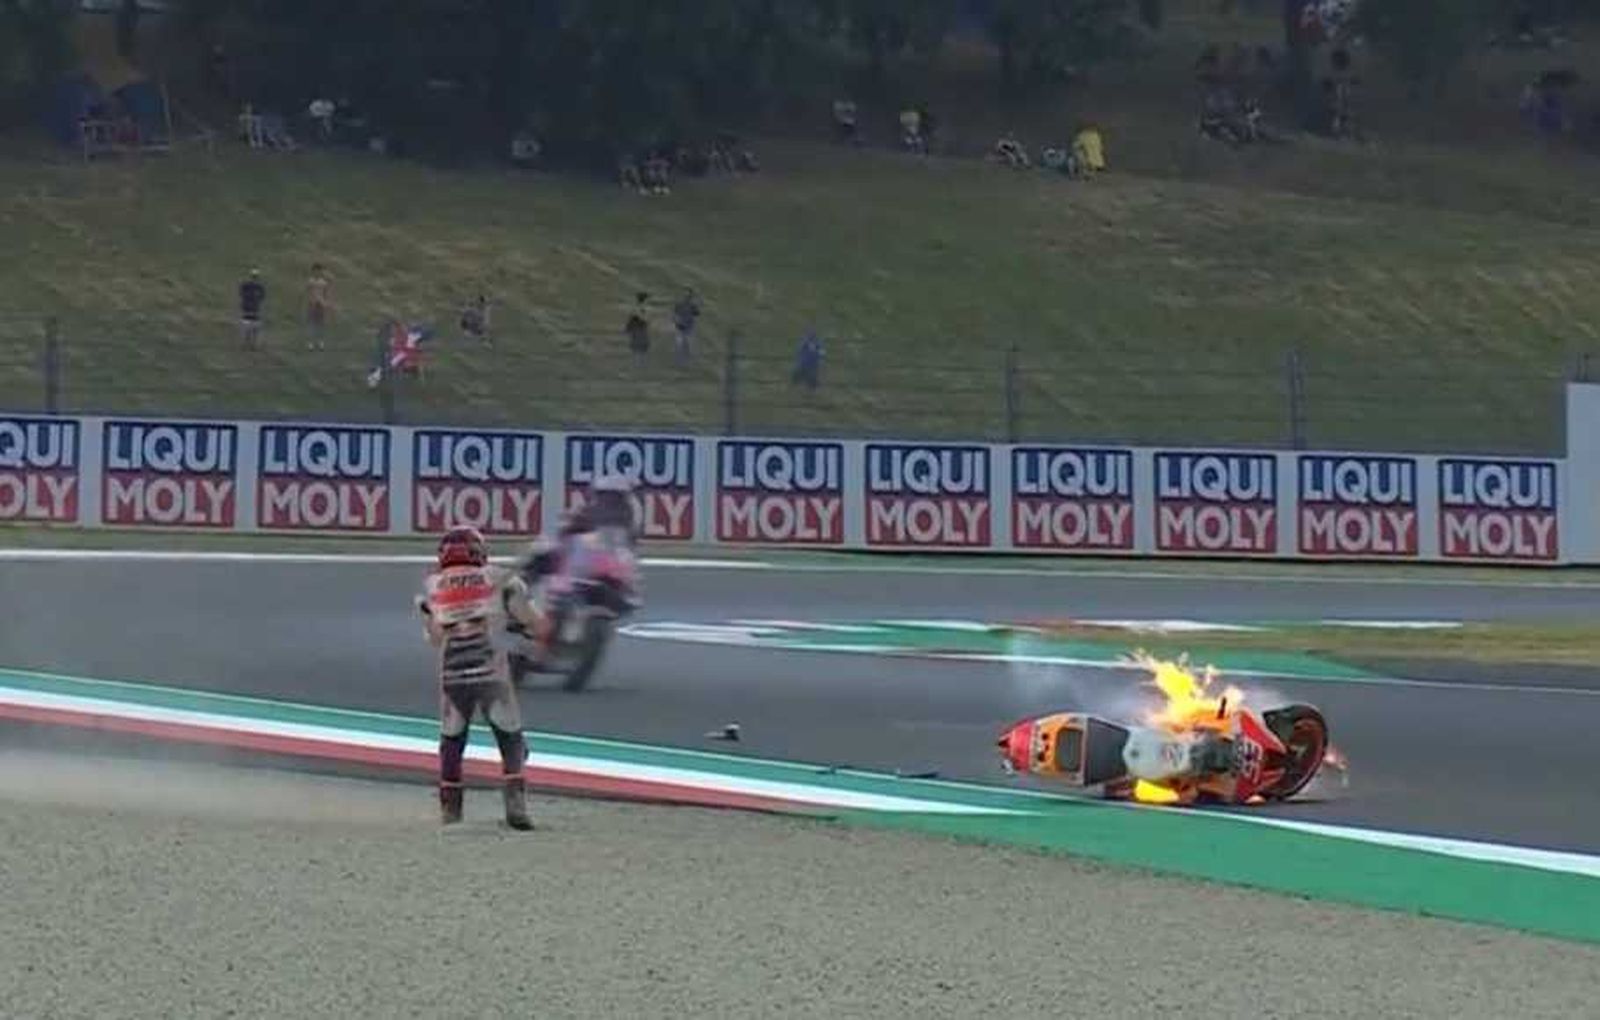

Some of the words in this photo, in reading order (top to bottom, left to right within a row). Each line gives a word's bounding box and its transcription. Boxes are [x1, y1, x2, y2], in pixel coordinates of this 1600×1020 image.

[108, 424, 232, 472] LIQUI
[263, 430, 385, 476] LIQUI
[418, 434, 540, 481] LIQUI
[570, 440, 688, 487] LIQUI
[722, 445, 838, 491] LIQUI
[869, 449, 985, 494] LIQUI
[1016, 451, 1130, 496] LIQUI
[1158, 455, 1273, 501] LIQUI
[1302, 458, 1412, 503] LIQUI
[1442, 462, 1552, 507] LIQUI
[106, 477, 232, 522] MOLY
[262, 481, 387, 527] MOLY
[416, 485, 541, 531] MOLY
[721, 496, 840, 541] MOLY
[869, 500, 988, 544] MOLY
[1016, 502, 1132, 545] MOLY
[1158, 507, 1275, 550] MOLY
[1302, 508, 1415, 553] MOLY
[1443, 513, 1554, 556] MOLY
